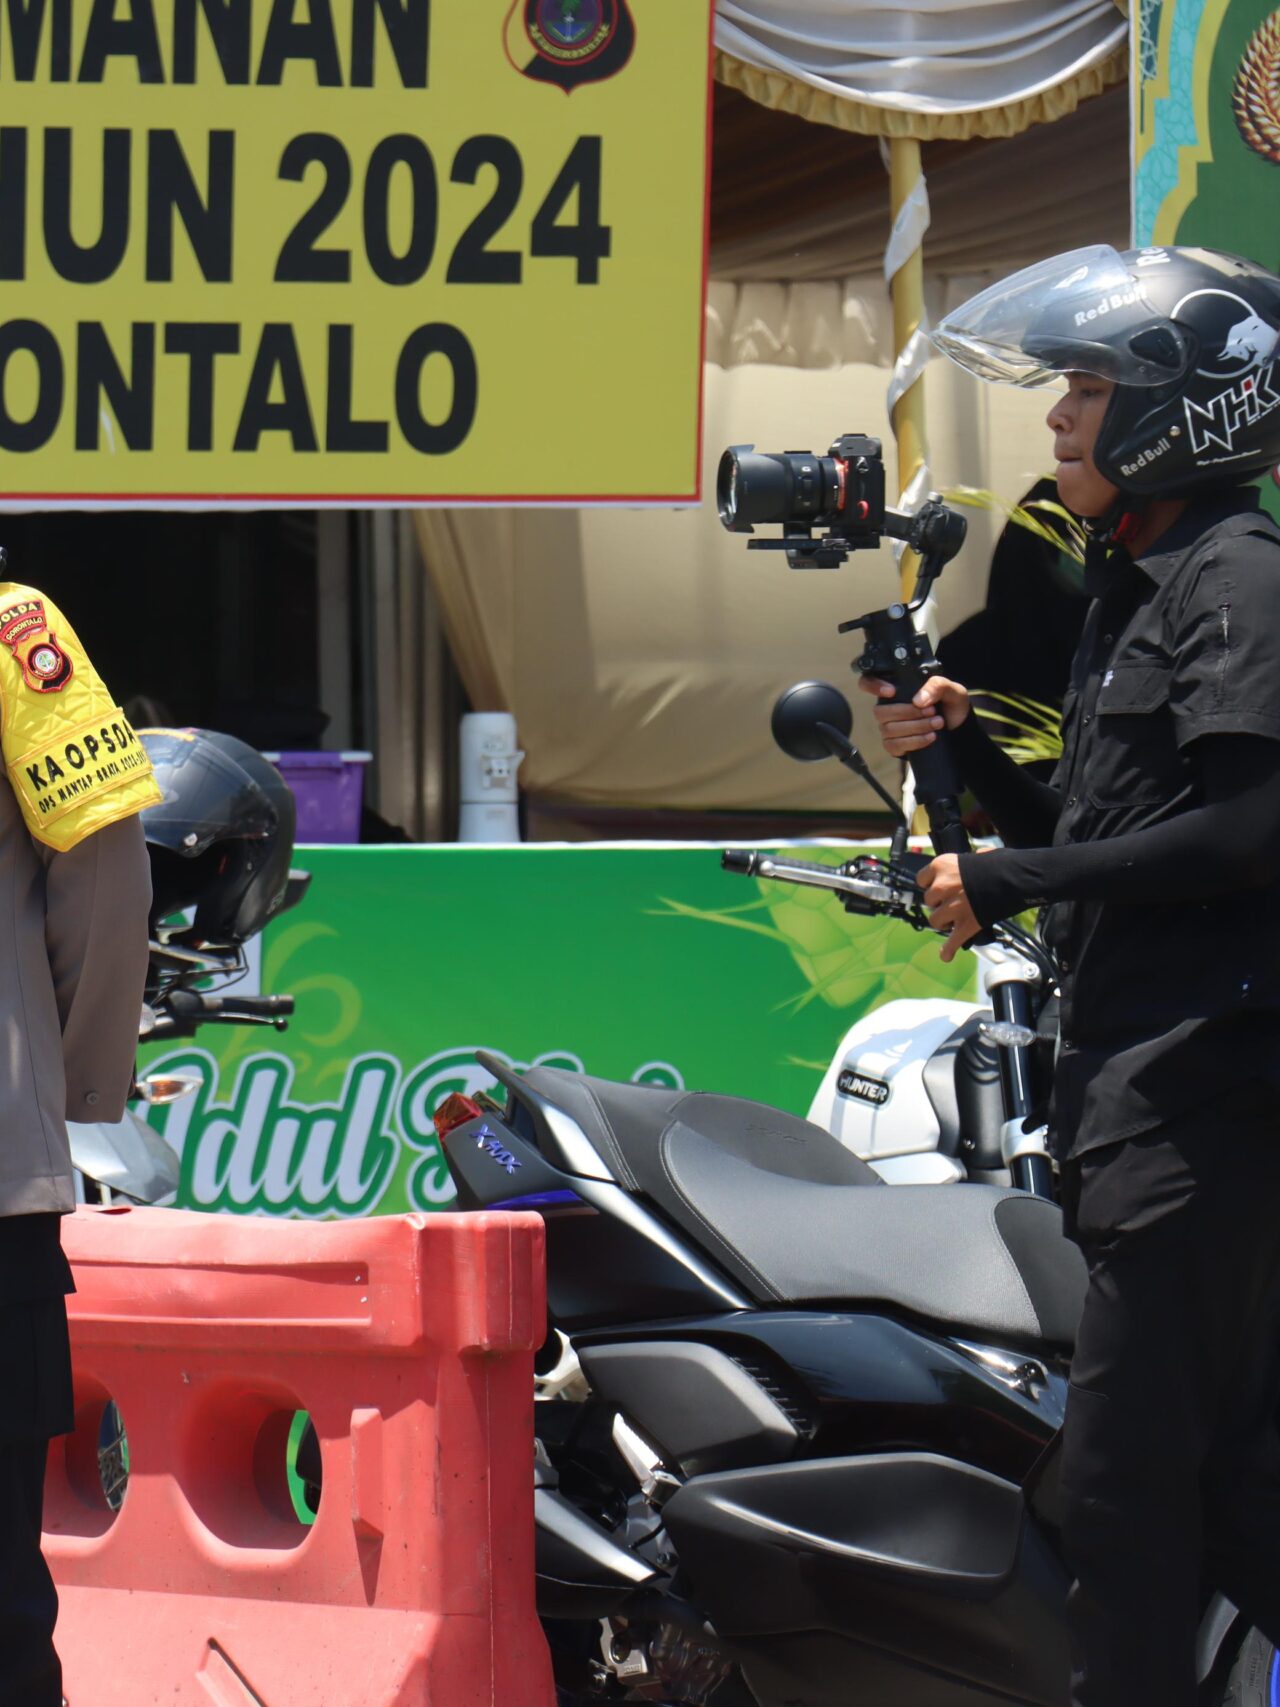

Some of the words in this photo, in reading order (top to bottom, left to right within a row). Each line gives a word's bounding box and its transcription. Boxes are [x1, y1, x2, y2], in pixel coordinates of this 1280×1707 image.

[273, 132, 610, 286] 2024
[1182, 361, 1280, 454] NHK
[6, 616, 43, 641] GORONTALO
[57, 774, 94, 803] MANTAP
[839, 1075, 888, 1102] HUNTER
[468, 1123, 523, 1175] XMAX
